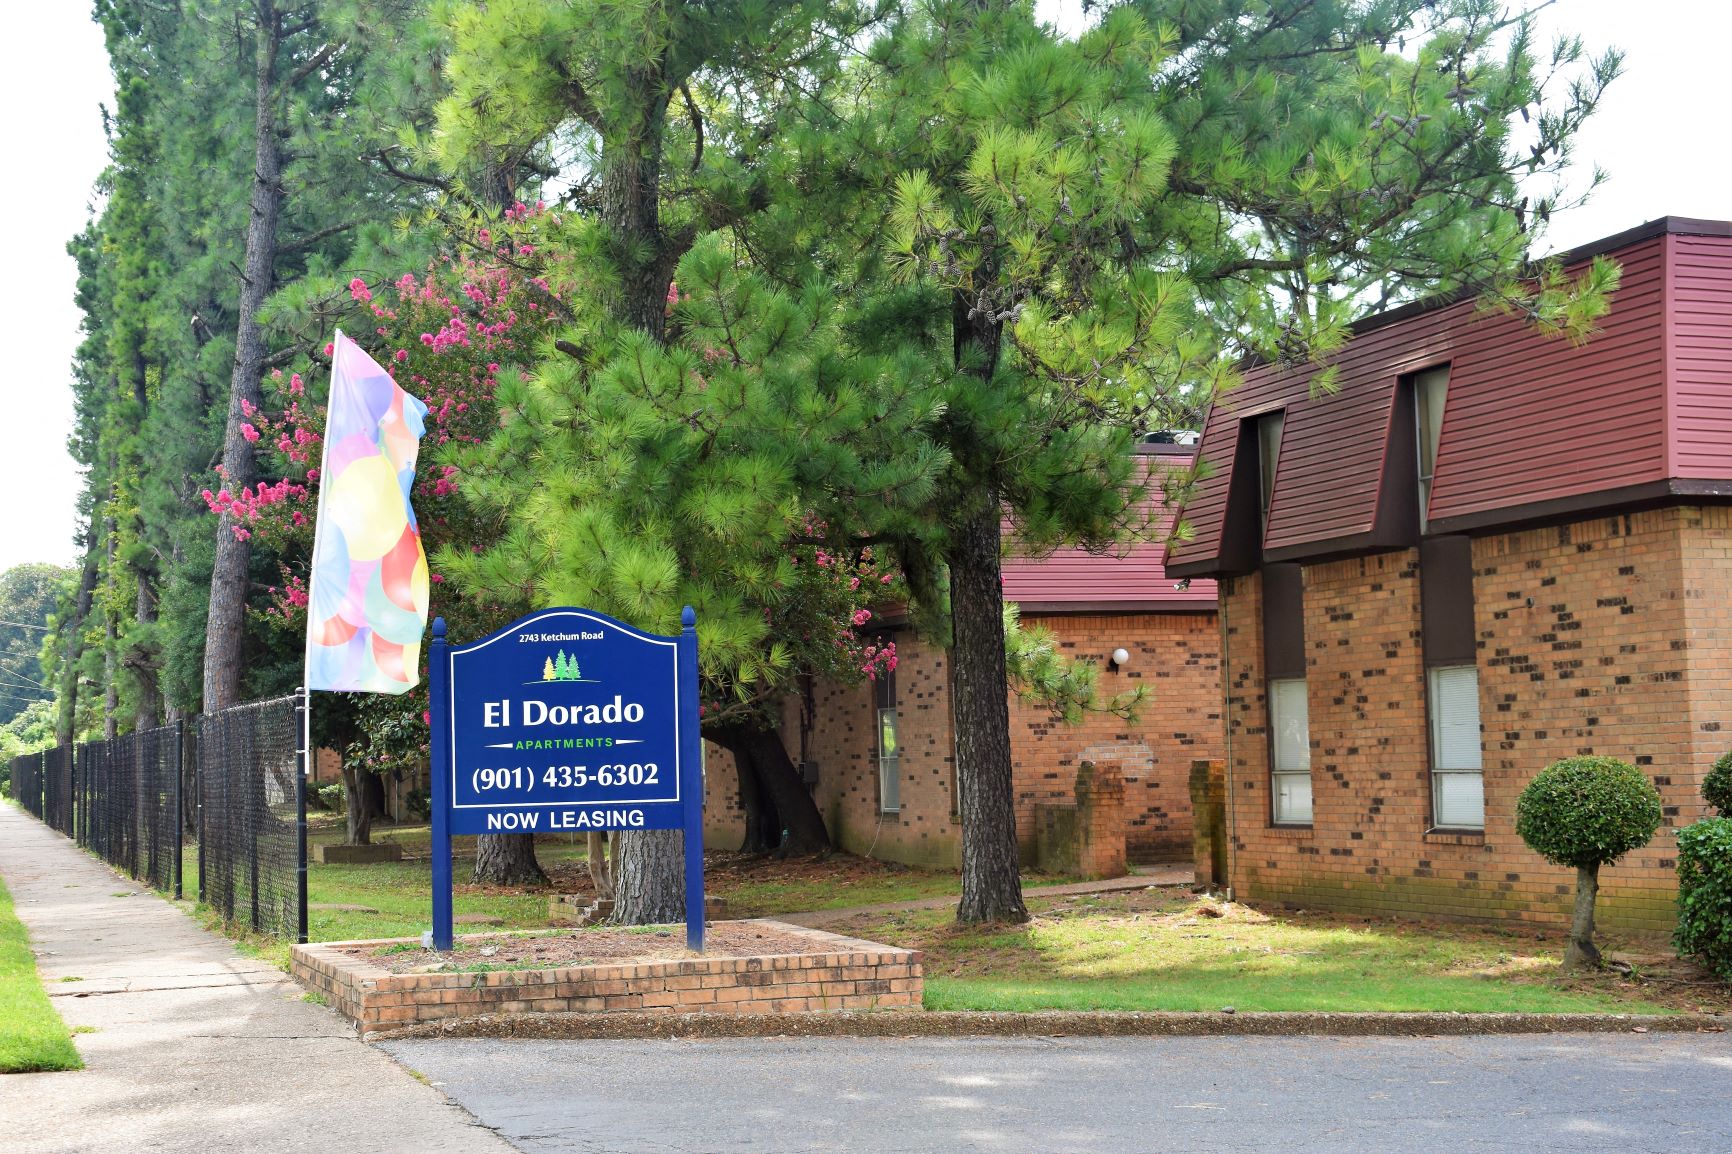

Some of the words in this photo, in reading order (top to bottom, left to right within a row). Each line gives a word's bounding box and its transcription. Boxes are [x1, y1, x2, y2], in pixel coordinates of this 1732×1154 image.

[520, 634, 539, 642] 2743
[541, 633, 579, 641] Ketchum
[581, 631, 603, 639] Road
[484, 700, 509, 727] El
[523, 695, 644, 726] Dorado
[516, 738, 612, 750] APARTMENTS
[473, 767, 534, 793] (901)
[543, 764, 658, 787] 435-6302
[488, 810, 539, 829] NOW
[551, 810, 644, 828] LEASING
